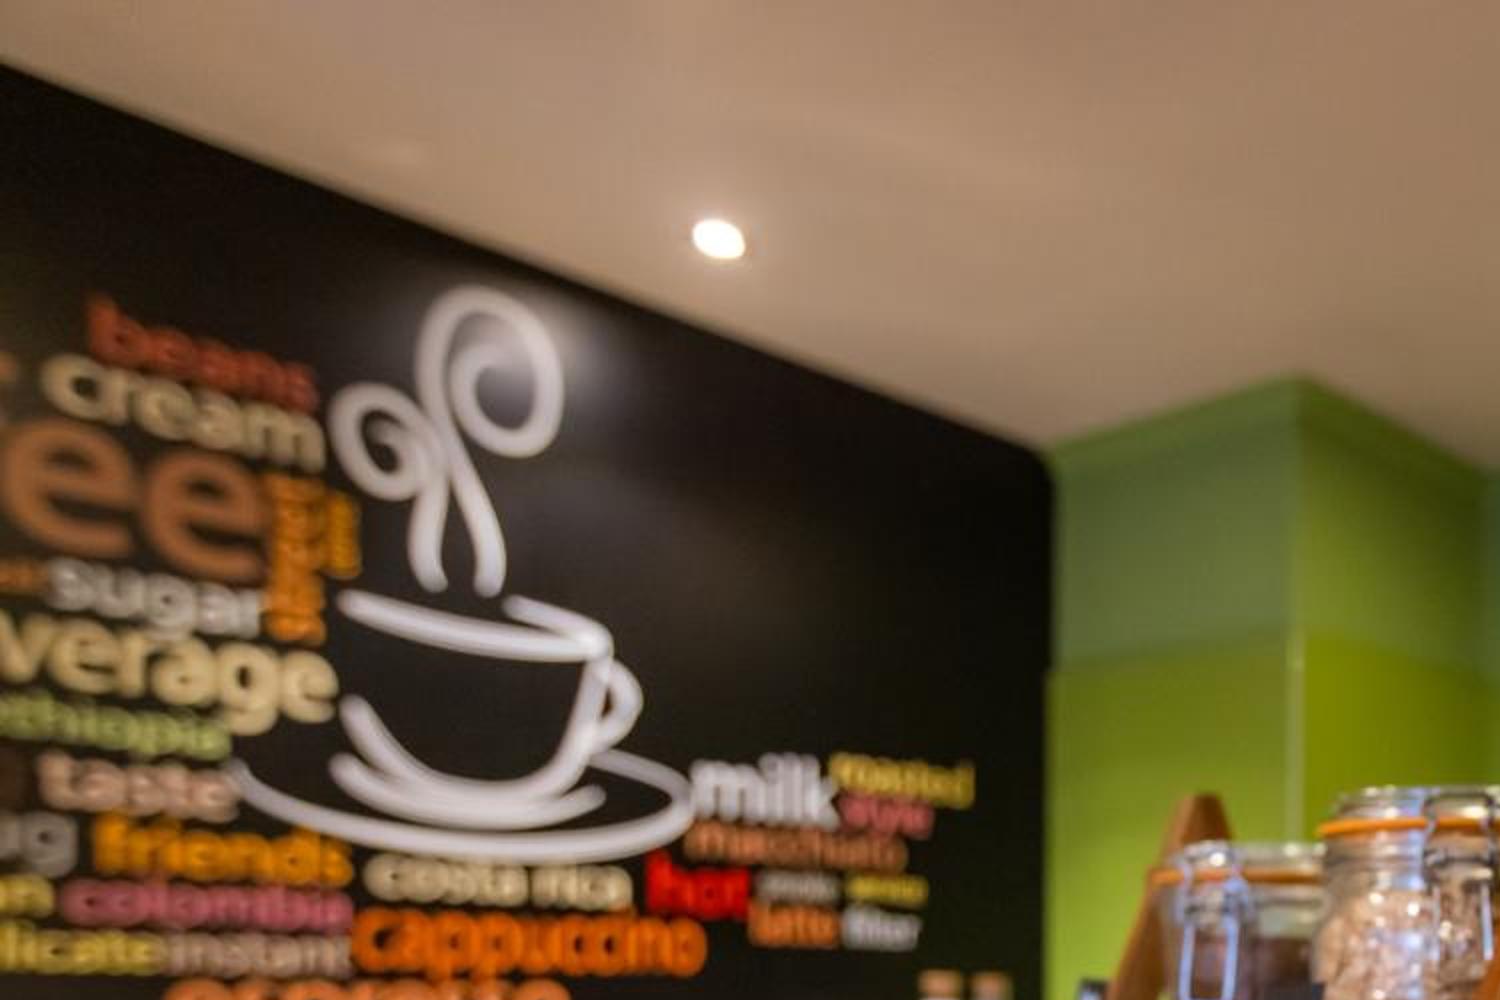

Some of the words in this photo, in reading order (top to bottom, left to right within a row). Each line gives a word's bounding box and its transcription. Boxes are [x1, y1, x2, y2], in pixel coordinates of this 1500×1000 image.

[42, 354, 326, 472] cream
[48, 558, 266, 642] sugar
[0, 602, 338, 734] verage
[37, 750, 240, 823] taste
[690, 753, 840, 830] milk
[94, 812, 354, 888] friends
[362, 852, 529, 904] costa
[531, 863, 634, 911] rica
[645, 848, 750, 922] hot
[352, 906, 707, 984] cappuccino
